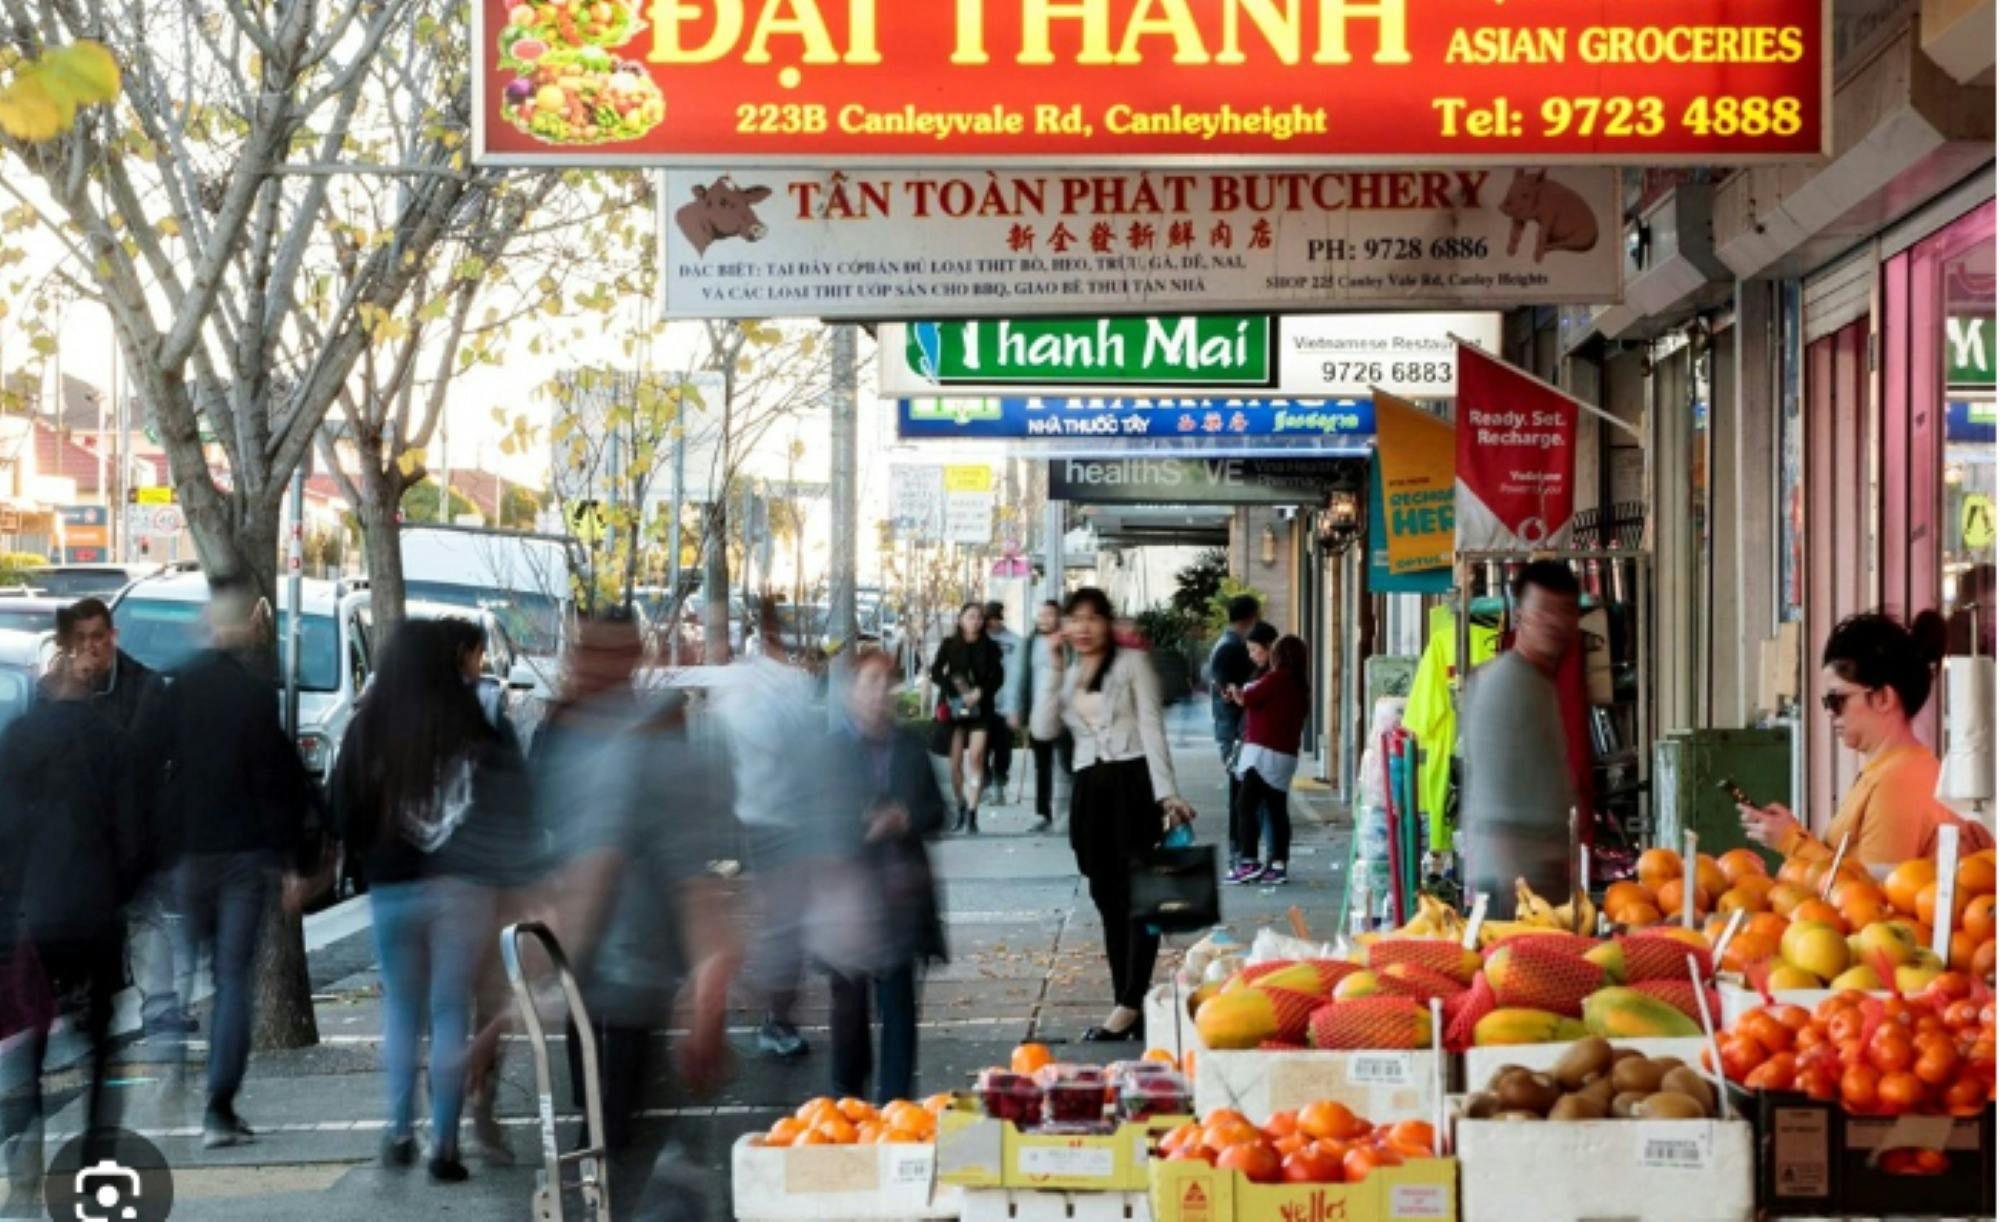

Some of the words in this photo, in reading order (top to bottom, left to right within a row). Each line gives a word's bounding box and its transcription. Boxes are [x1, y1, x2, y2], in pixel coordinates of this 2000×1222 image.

[1445, 27, 1566, 64] ASIAN
[1577, 26, 1804, 64] GROCERIES
[735, 105, 827, 134] 223B
[837, 104, 1024, 140] Canleyvale
[1033, 104, 1094, 137] Rd,
[1105, 104, 1328, 140] Canleyheight
[1433, 97, 1523, 138] Tel:
[1540, 97, 1665, 137] 9723
[1681, 97, 1803, 136] 4888
[787, 169, 893, 220] TÂN
[904, 169, 1047, 218] TOÀN
[1209, 169, 1490, 212] BUTCHERY
[1306, 238, 1357, 261] PH:
[1364, 236, 1423, 260] 9728
[1428, 235, 1490, 260] 6886
[1337, 274, 1384, 290] Canley
[1386, 272, 1417, 287] Vale
[1447, 273, 1494, 289] Canley
[1497, 272, 1549, 288] Heights
[1141, 316, 1249, 370] Mai
[1391, 335, 1483, 352] Restaurt
[1321, 361, 1384, 384] 9726
[1391, 361, 1454, 384] 6883
[1468, 409, 1528, 430] Ready.
[1531, 410, 1567, 427] Set.
[1477, 428, 1566, 449] Recharge.
